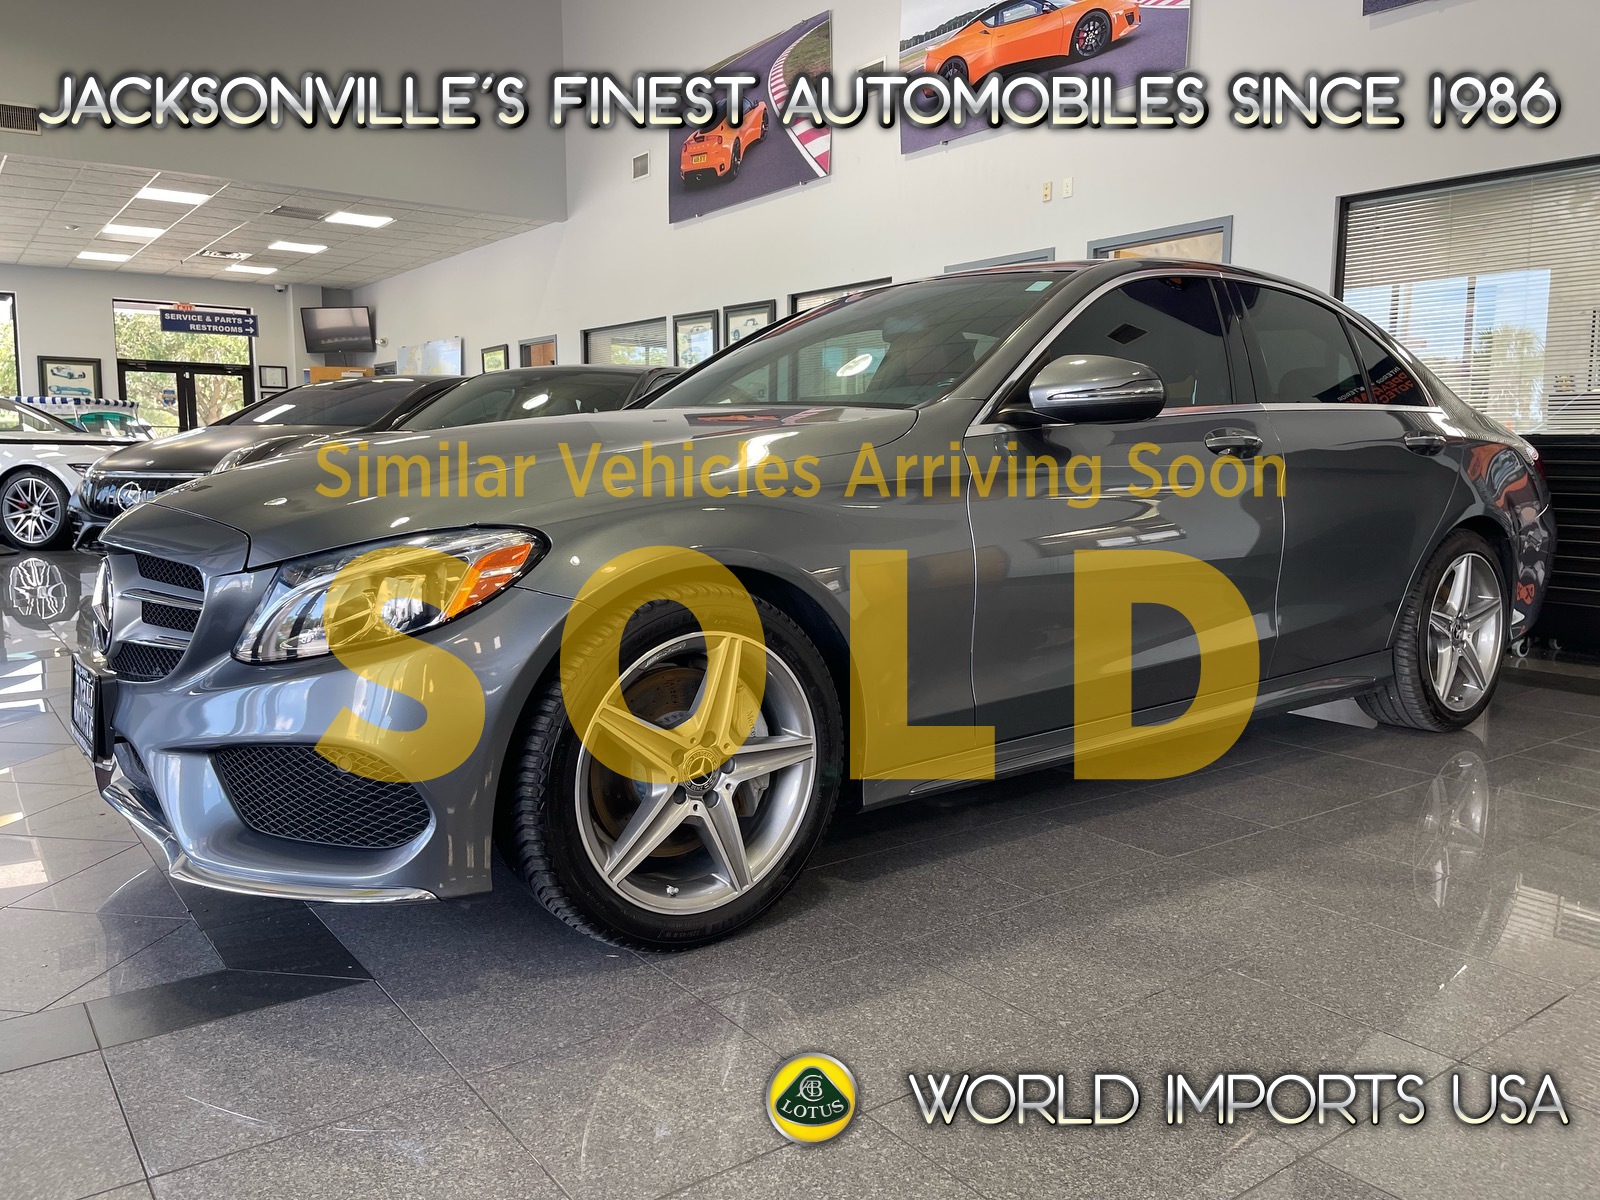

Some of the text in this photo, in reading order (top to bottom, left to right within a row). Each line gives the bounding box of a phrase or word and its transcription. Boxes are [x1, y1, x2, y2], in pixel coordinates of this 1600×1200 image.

[164, 312, 243, 325] SERVICE & PARTS
[189, 323, 244, 334] RESTROOMS
